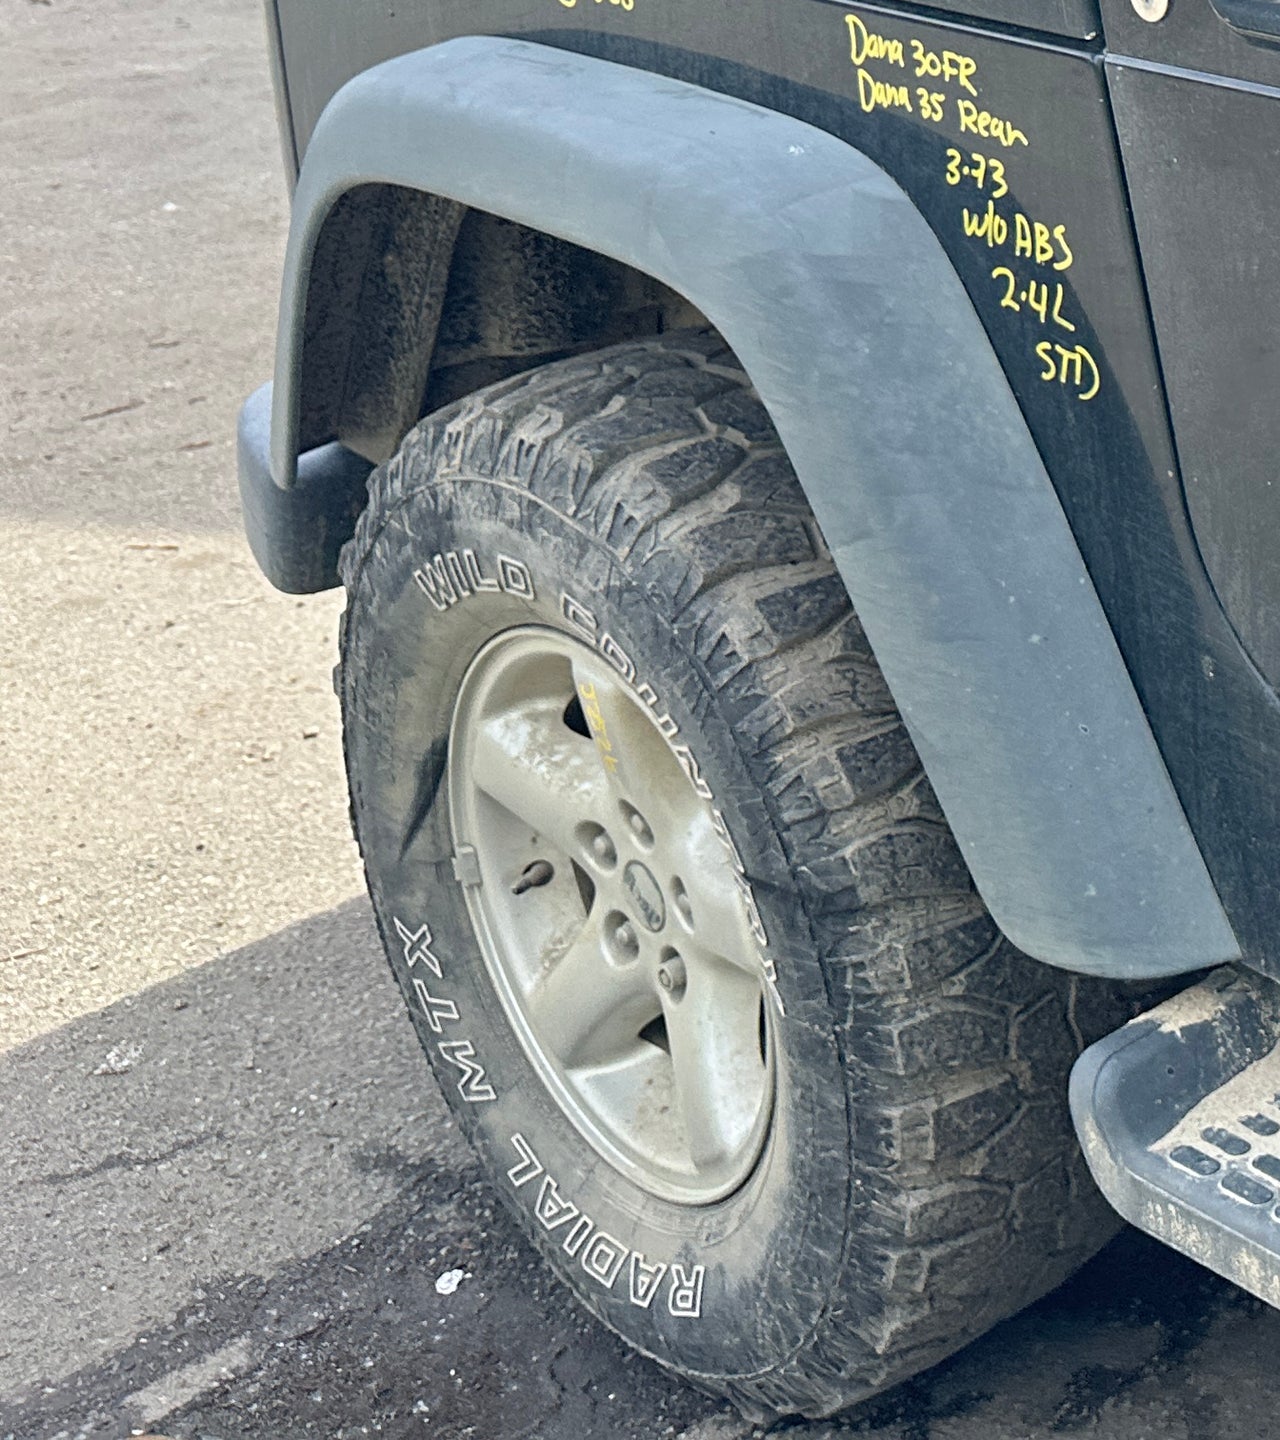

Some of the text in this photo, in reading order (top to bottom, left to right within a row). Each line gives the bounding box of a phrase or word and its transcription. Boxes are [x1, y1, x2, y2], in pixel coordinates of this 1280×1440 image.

[845, 14, 905, 68] Dana
[857, 68, 1029, 147] Dana 35 Rear
[1015, 213, 1073, 271] ABS
[1035, 341, 1100, 401] STD
[413, 547, 536, 612] WILD
[506, 1132, 706, 1319] RADIAL
